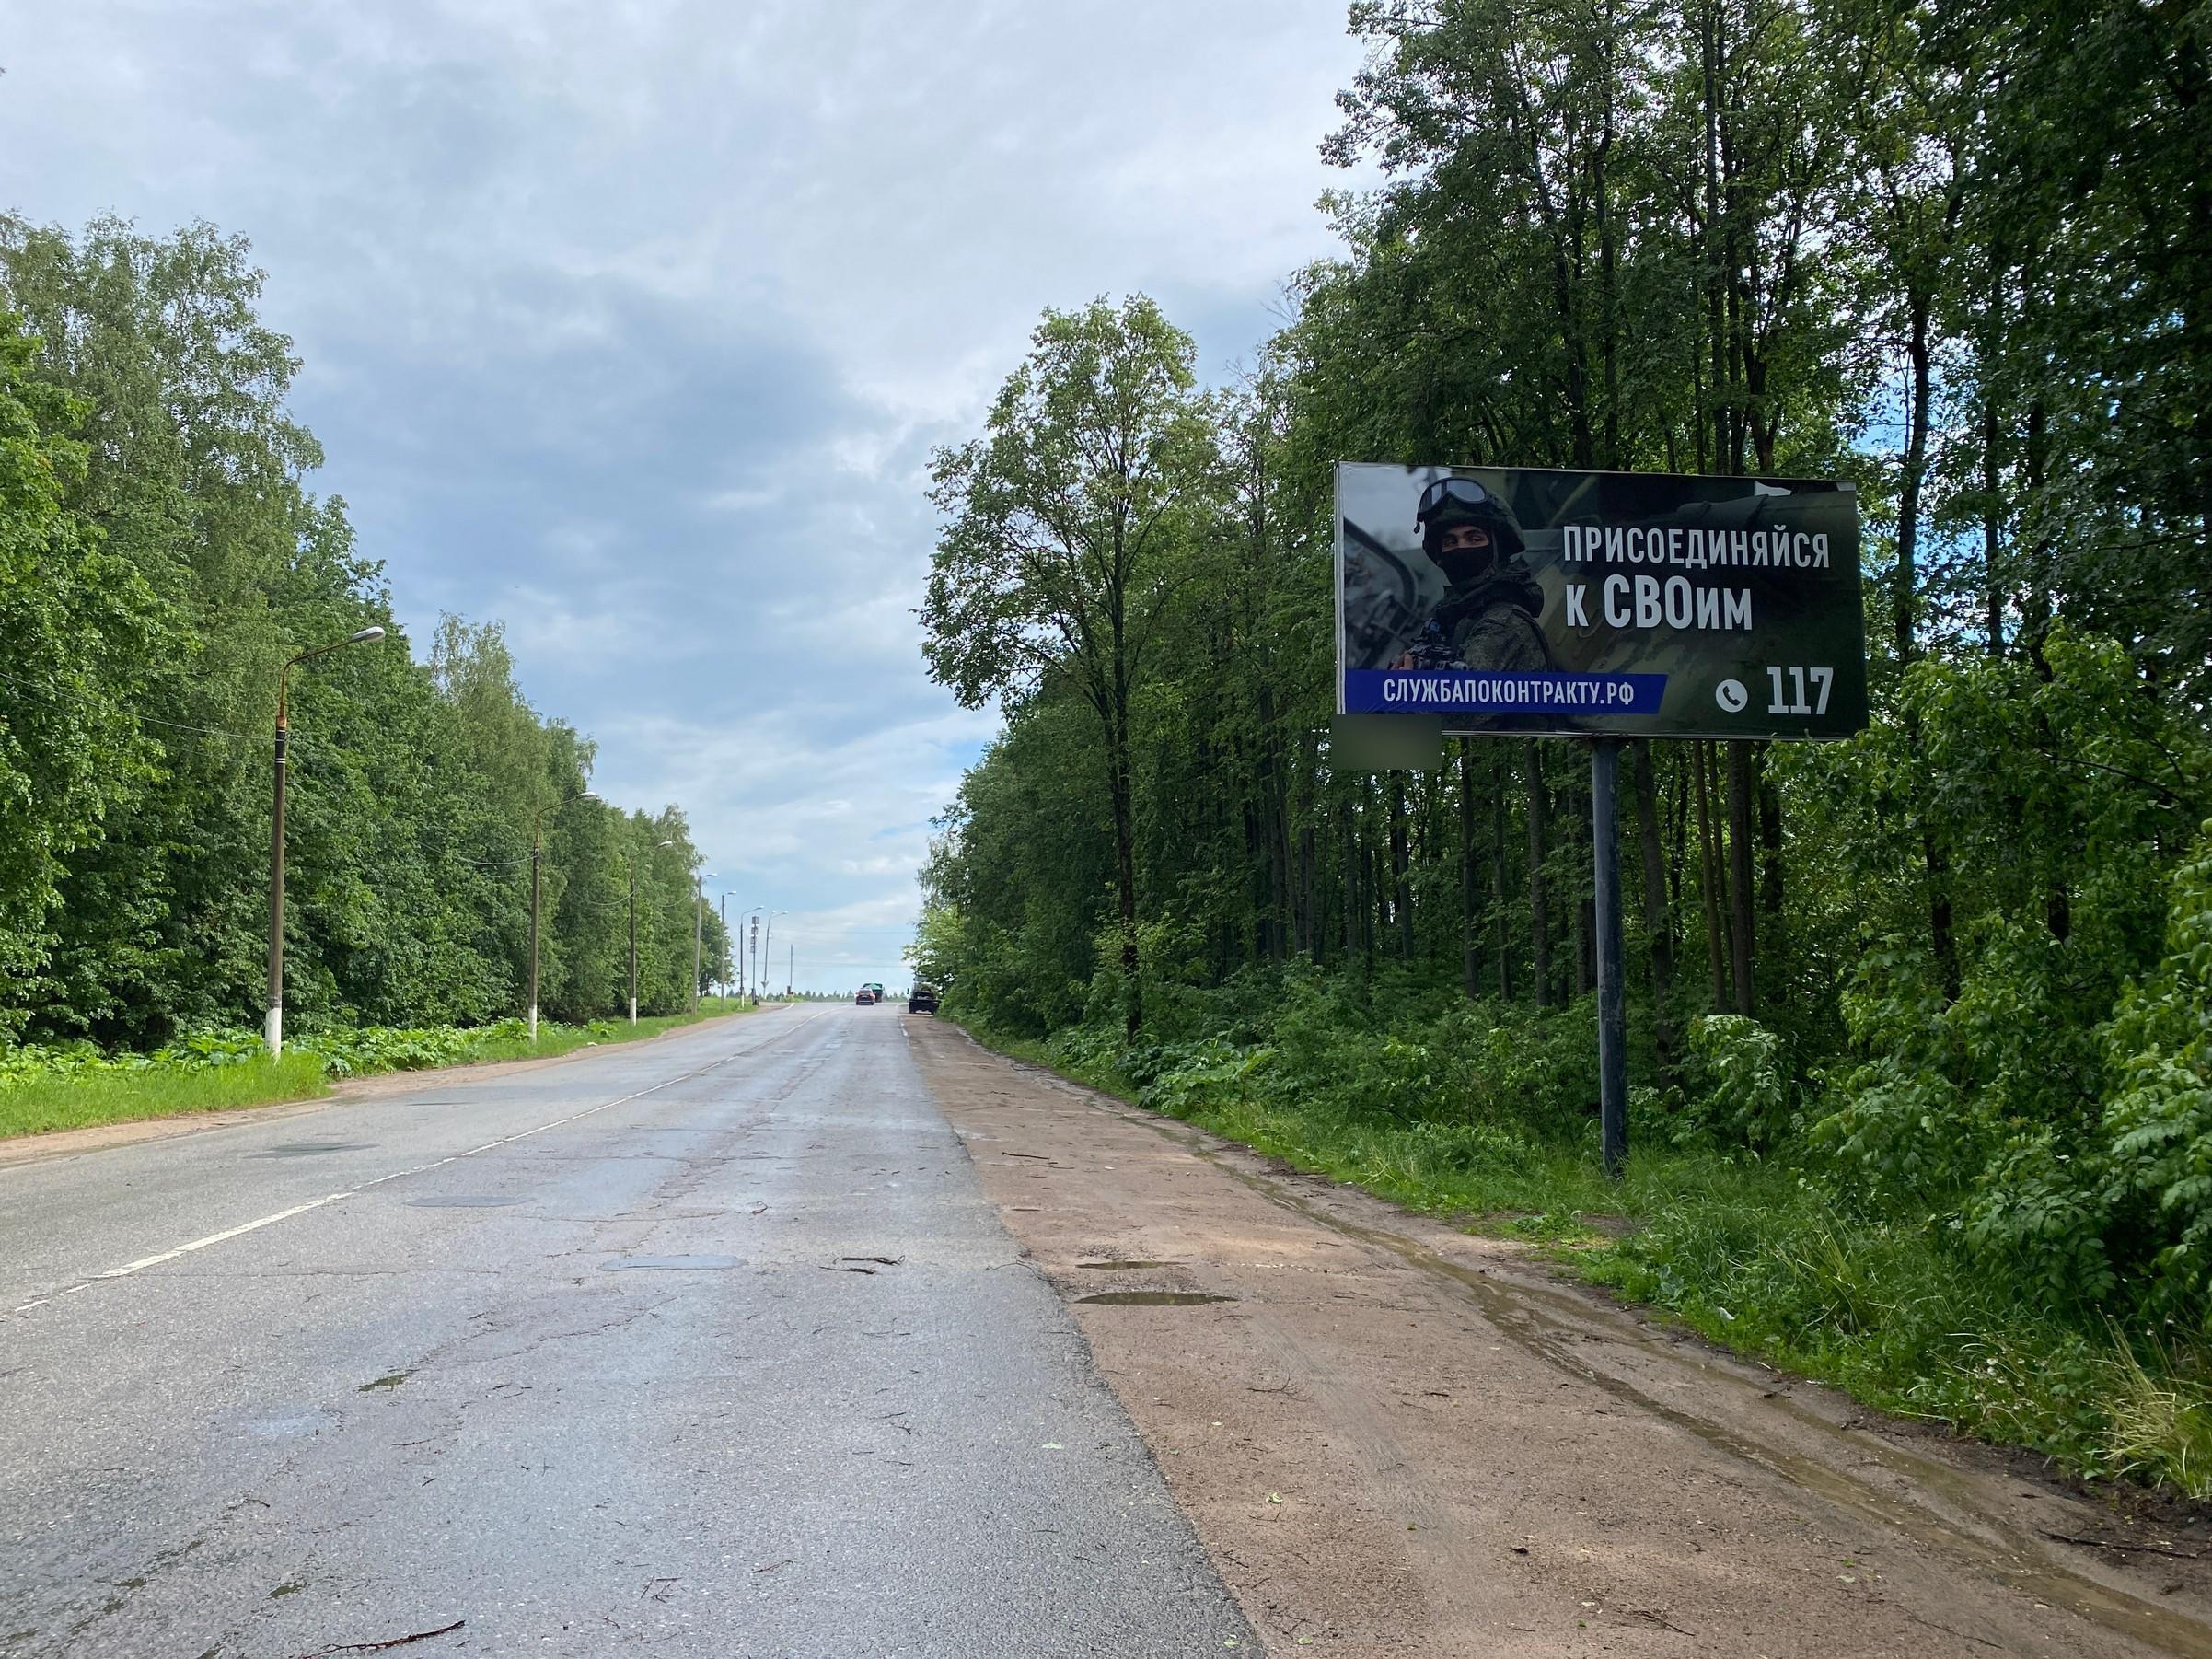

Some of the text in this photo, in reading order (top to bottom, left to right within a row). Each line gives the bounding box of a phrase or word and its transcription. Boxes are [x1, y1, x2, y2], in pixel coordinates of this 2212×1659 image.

[1563, 524, 1830, 569] ПРИСОЕДИНЯЙСЯ
[1604, 574, 1753, 630] СВОим
[1384, 678, 1635, 706] СЛУЖБАПОКОНТРАКТУ.РФ
[1766, 666, 1835, 715] 117
